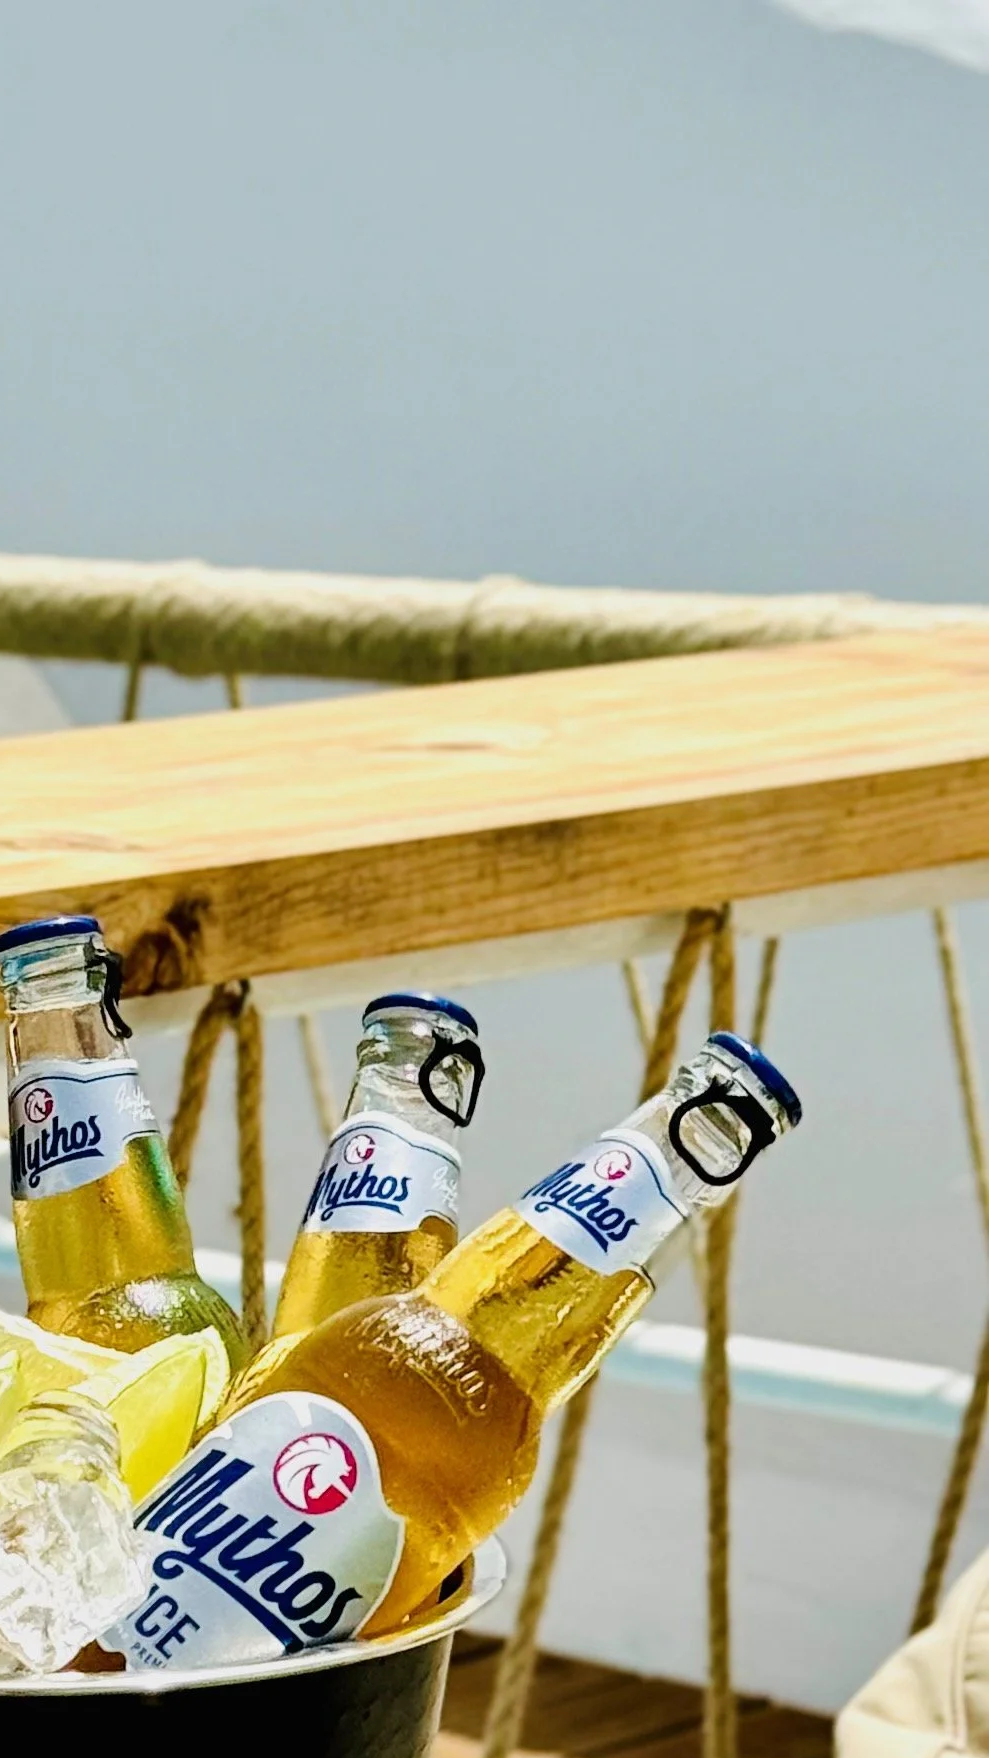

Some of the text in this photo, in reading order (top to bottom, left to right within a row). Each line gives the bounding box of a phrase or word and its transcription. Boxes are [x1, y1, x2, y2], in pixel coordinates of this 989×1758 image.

[11, 1114, 104, 1191] Mythos
[302, 1163, 412, 1226] Mythos
[521, 1163, 640, 1253] Mythos
[133, 1449, 363, 1656] Mythos
